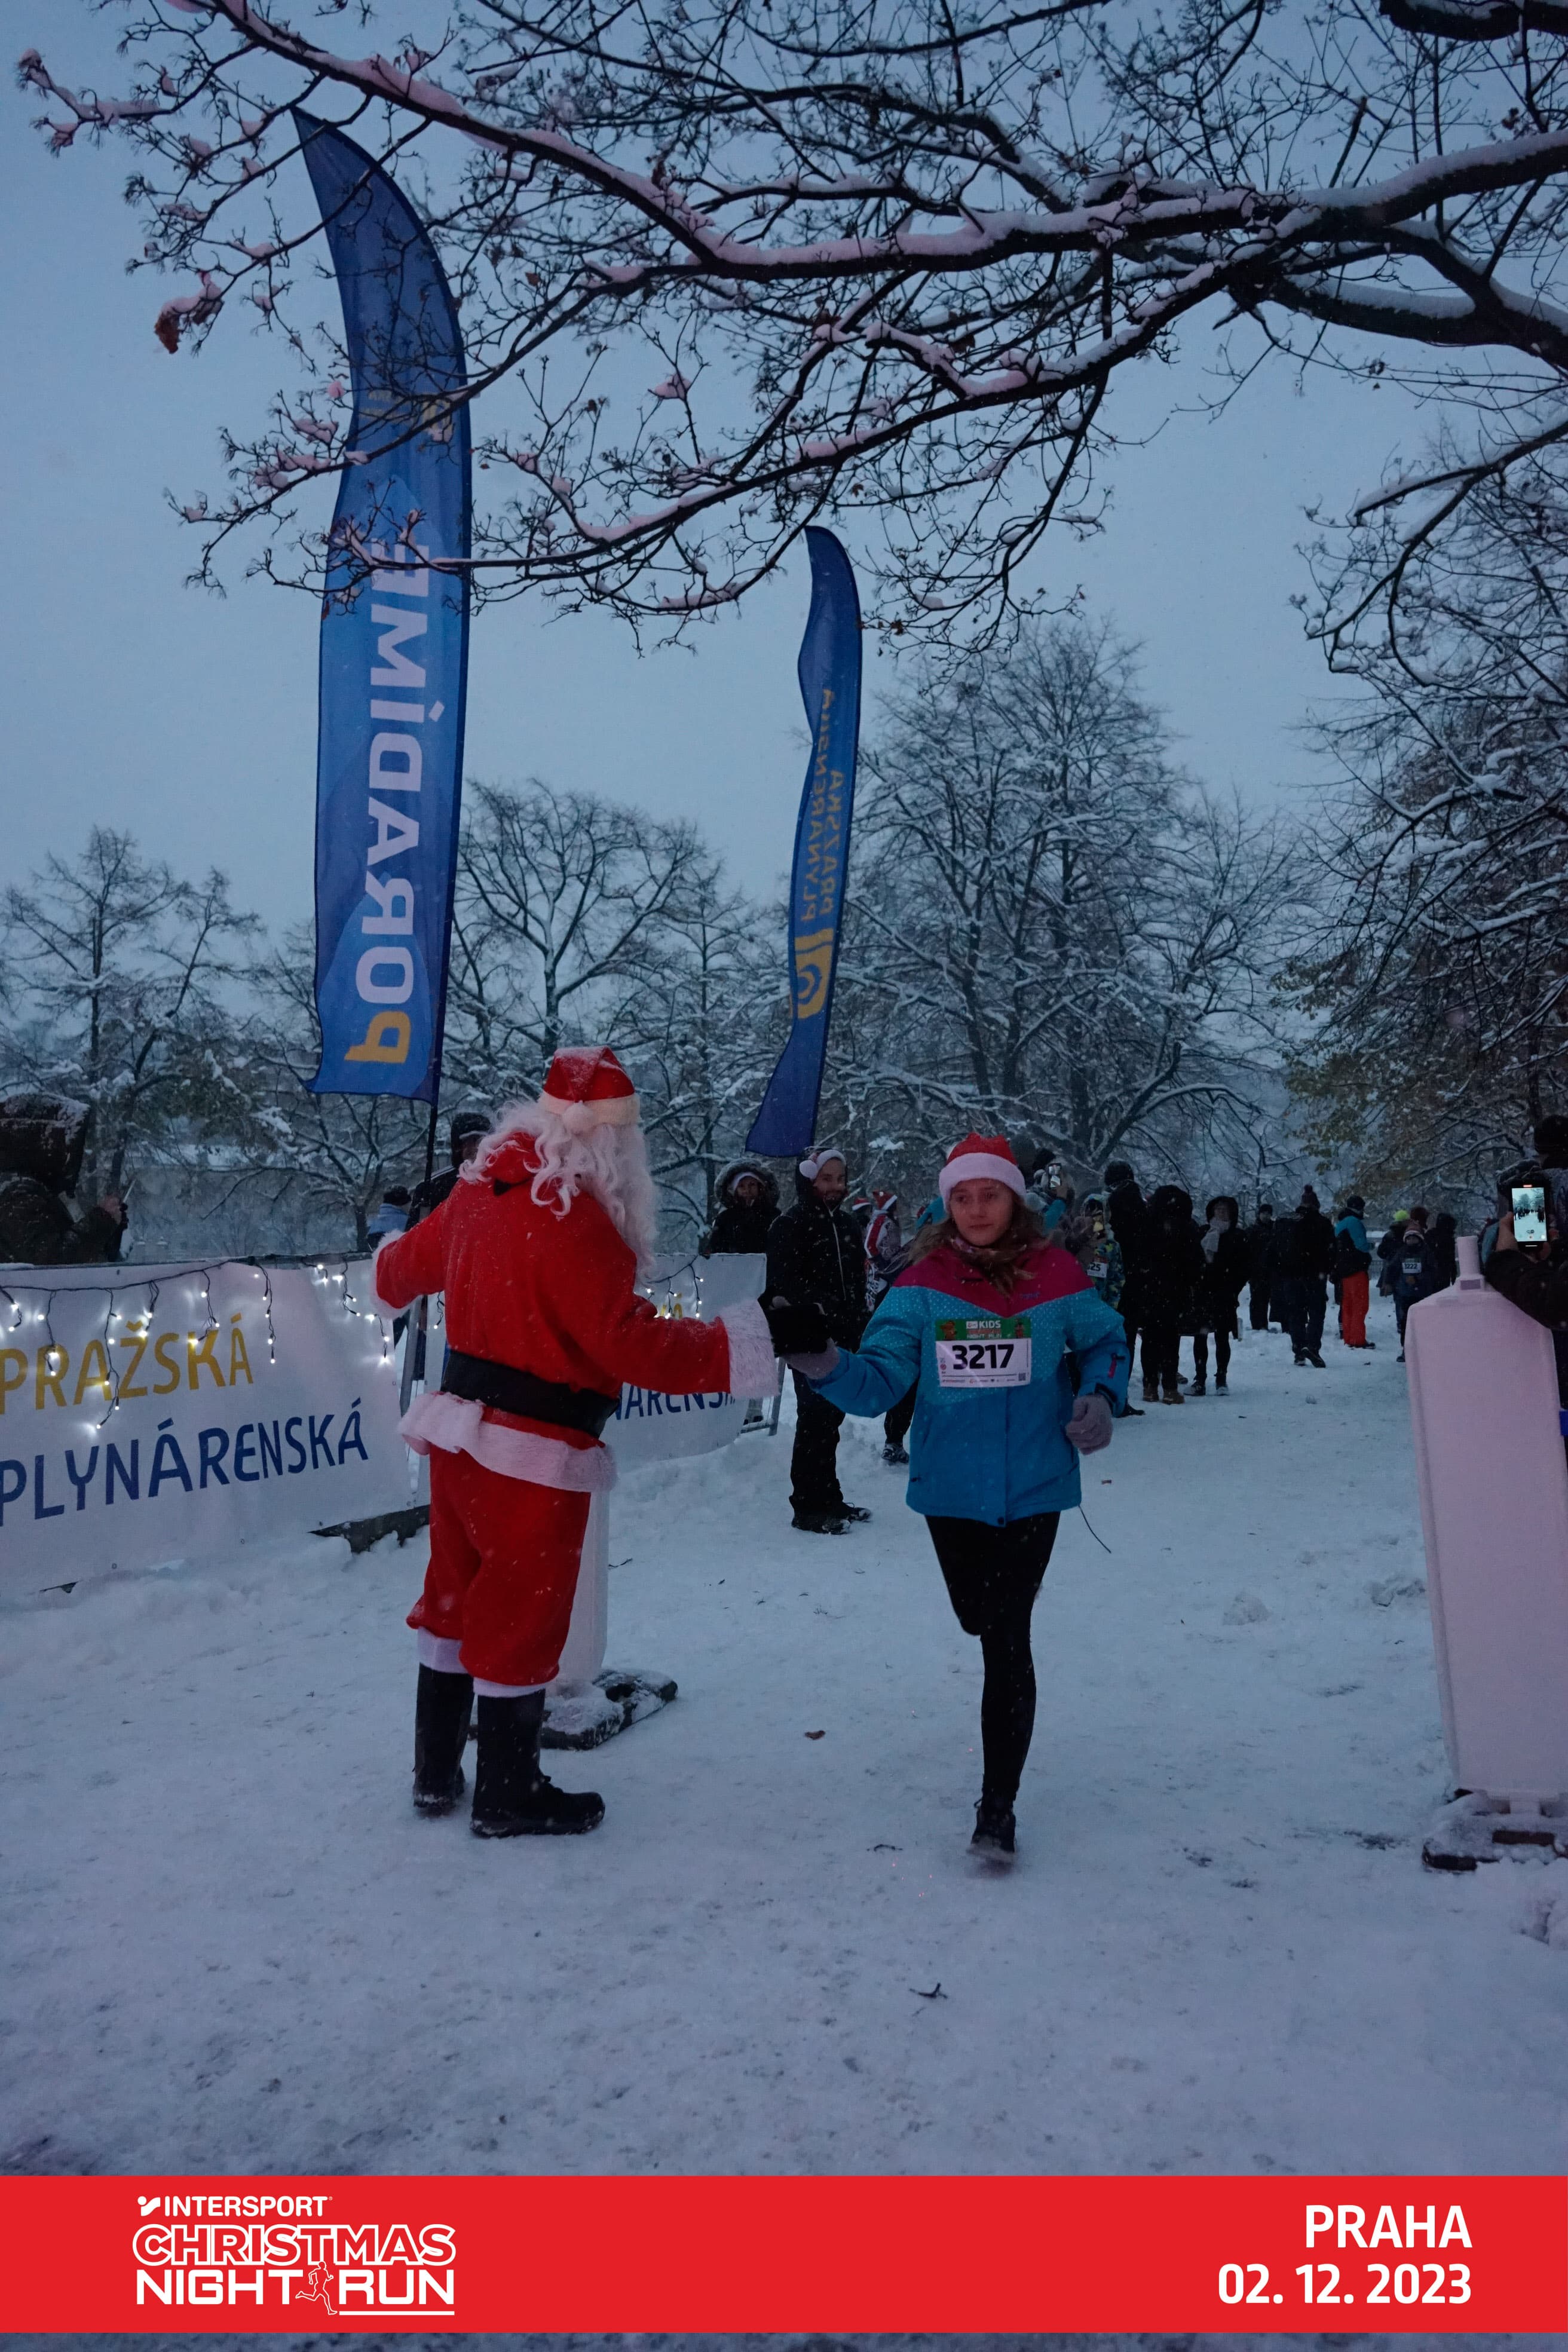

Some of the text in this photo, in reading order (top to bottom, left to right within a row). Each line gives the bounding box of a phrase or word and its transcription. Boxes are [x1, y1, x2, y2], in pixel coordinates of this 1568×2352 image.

[979, 1320, 1001, 1328] KIDS
[0, 1313, 253, 1414] PRAŽSKÁ
[952, 1344, 1014, 1370] 3217
[0, 1398, 368, 1526] PLYNÁRENSKÁ
